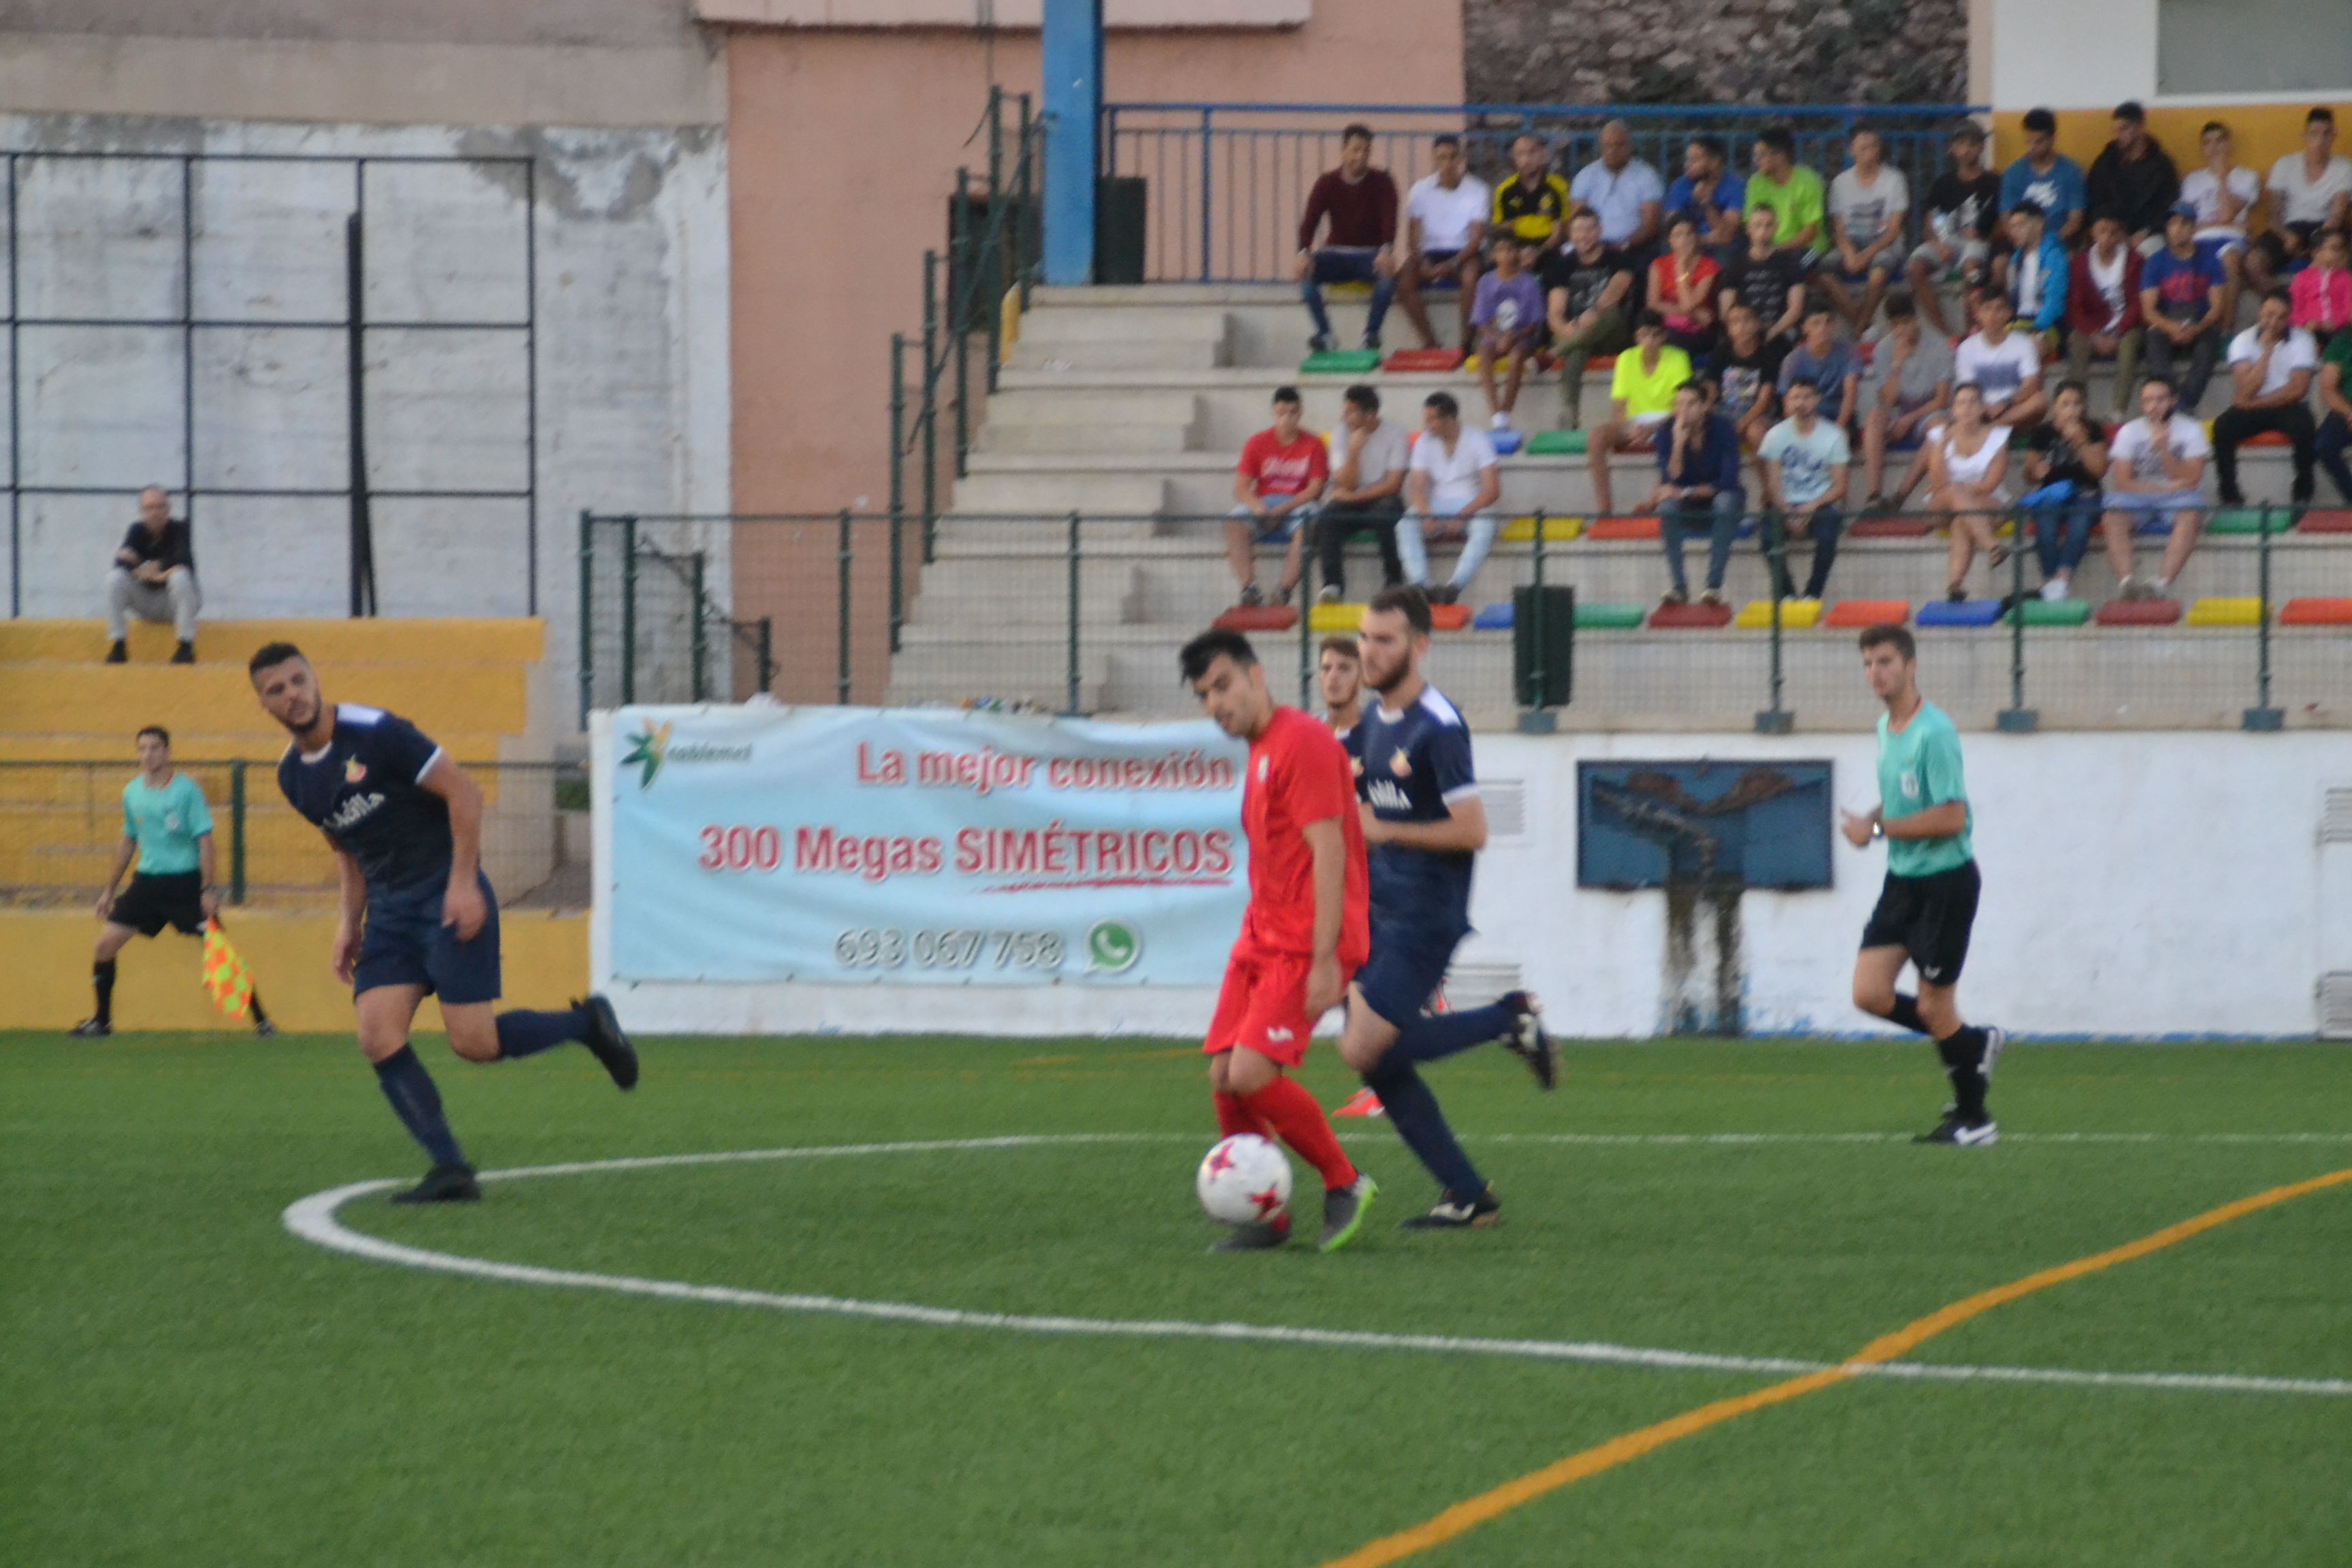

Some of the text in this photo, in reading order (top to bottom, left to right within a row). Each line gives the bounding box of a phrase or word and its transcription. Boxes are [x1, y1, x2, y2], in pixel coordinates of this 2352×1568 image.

[855, 740, 1235, 795] La mejor conexión
[697, 819, 1233, 883] 300 Megas SIMÉTRICOS
[834, 929, 1066, 969] 693 067 758
